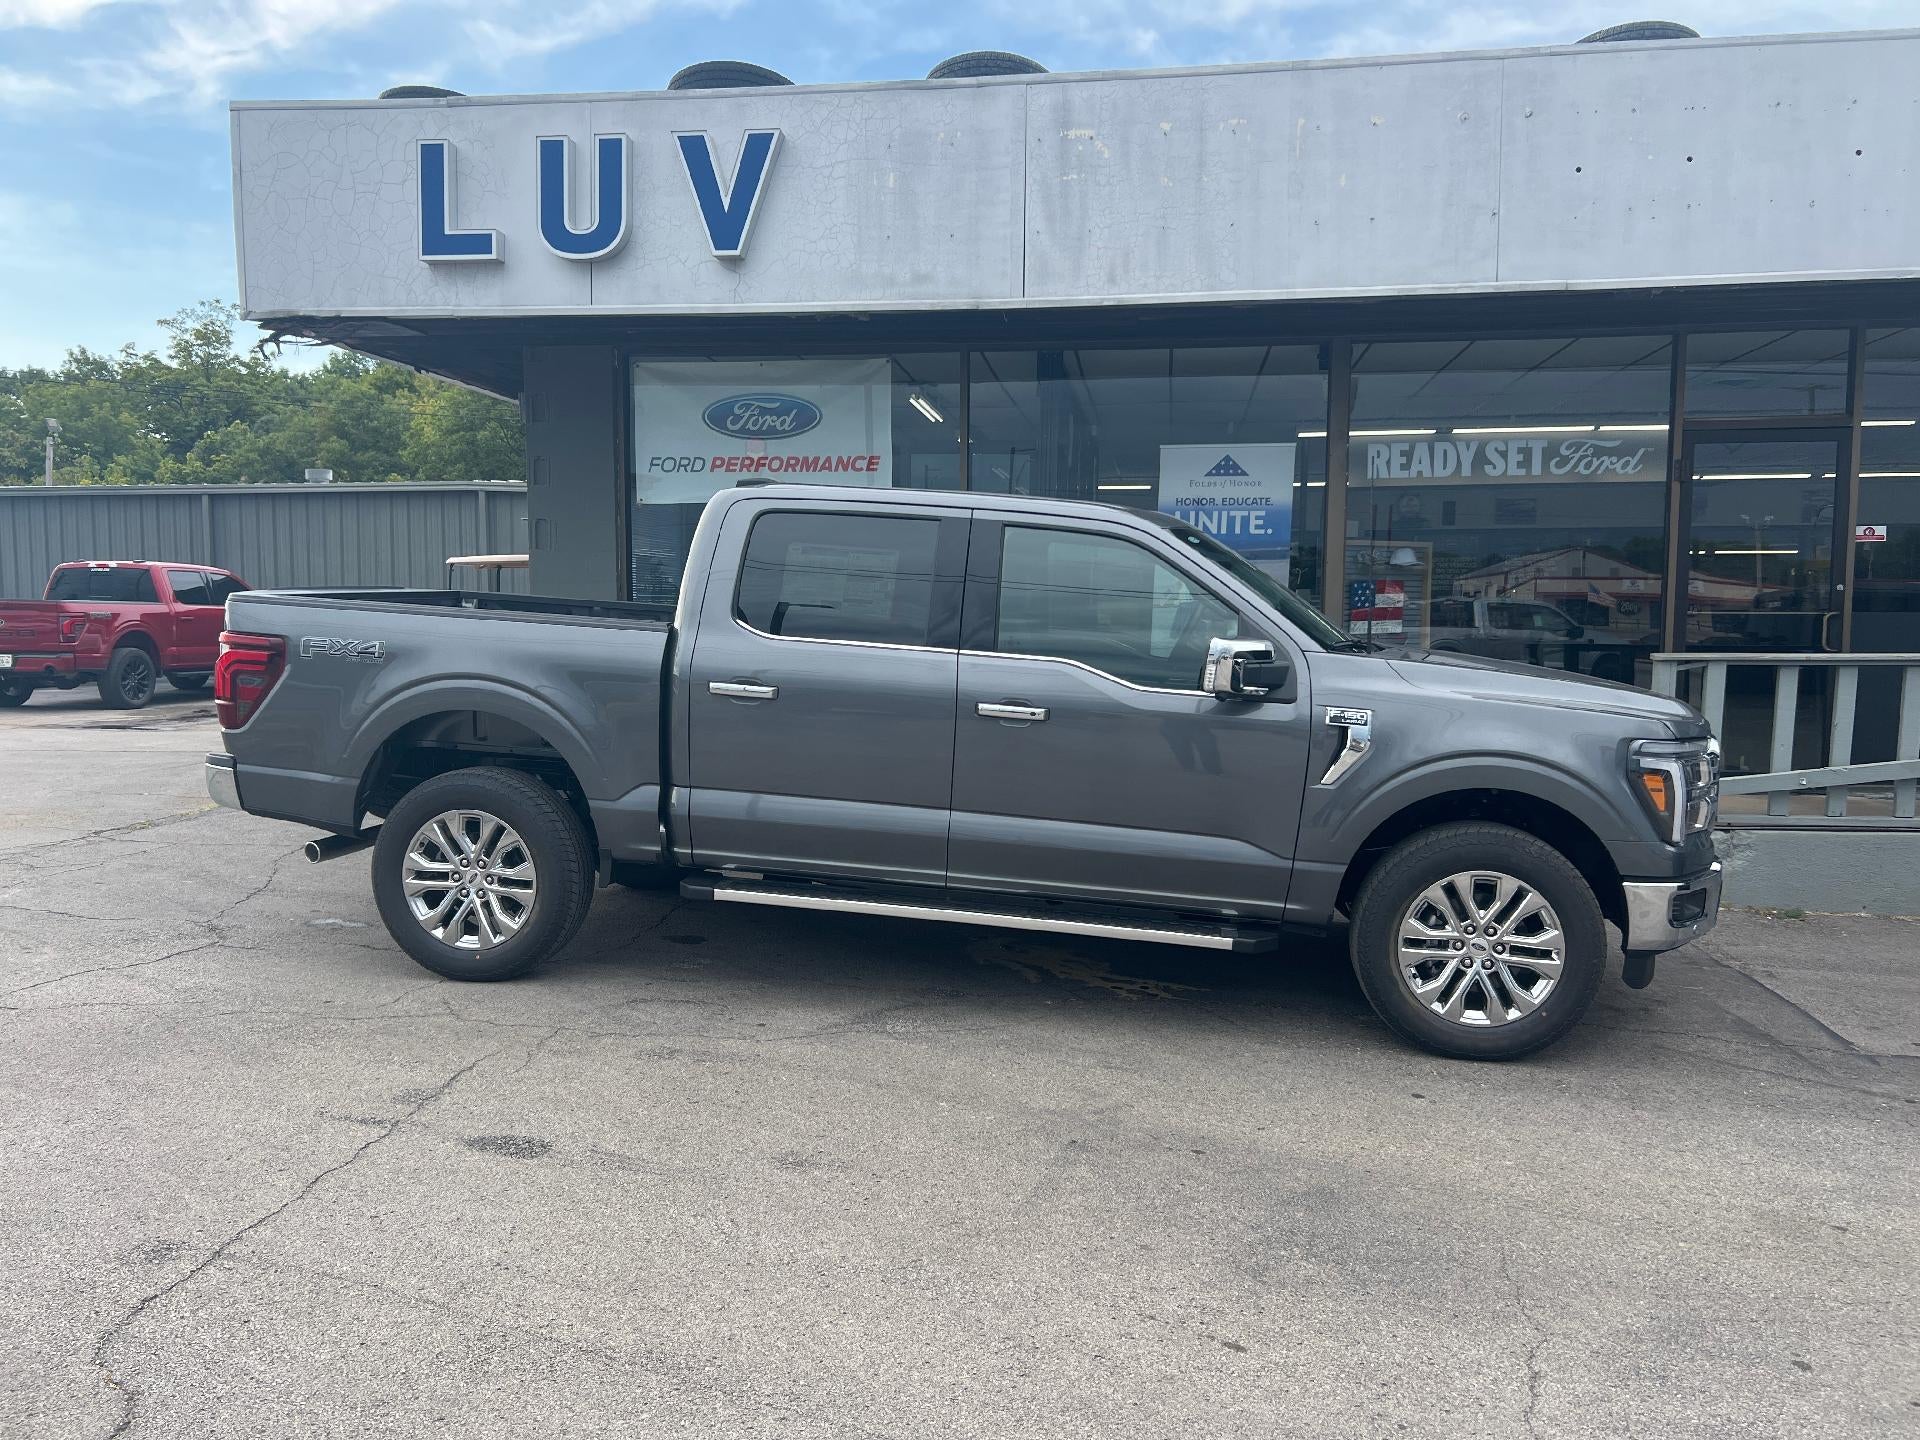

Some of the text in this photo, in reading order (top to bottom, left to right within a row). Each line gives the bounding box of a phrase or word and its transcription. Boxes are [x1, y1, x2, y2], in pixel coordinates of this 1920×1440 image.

[416, 128, 786, 262] LUV
[726, 400, 797, 432] Ford
[648, 455, 881, 473] FORD PERFORMANCE
[1367, 439, 1645, 479] READY SET Ford
[1175, 497, 1274, 506] HONOR. EDUCATE.
[300, 637, 385, 659] FX4
[1329, 710, 1367, 720] F-150
